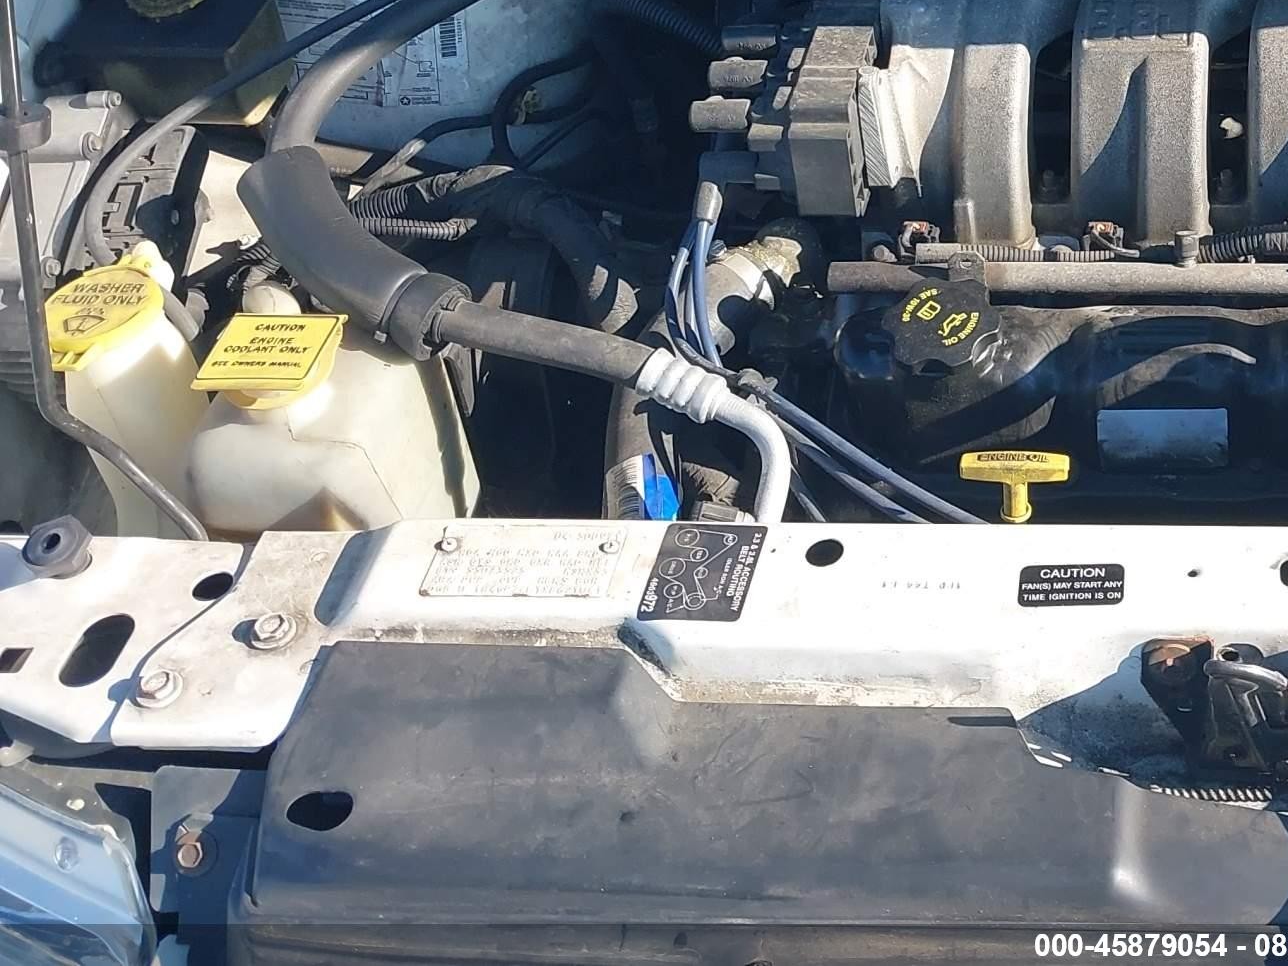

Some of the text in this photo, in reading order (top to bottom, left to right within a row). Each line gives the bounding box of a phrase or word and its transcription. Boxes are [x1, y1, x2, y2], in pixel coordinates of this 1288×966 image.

[72, 283, 145, 295] WASHER
[919, 288, 938, 300] SAE
[51, 294, 148, 305] FLUID ONLY
[255, 323, 306, 332] CAUTION
[941, 312, 980, 346] ENGINE OIL
[250, 337, 295, 345] ENGINE
[223, 345, 311, 354] COOLANT ONLY
[976, 452, 1048, 463] ENGINE OIL
[724, 545, 749, 596] BELT ROUTING
[1040, 567, 1106, 580] CAUTION
[728, 566, 752, 611] ACCESSORY
[1021, 580, 1123, 591] FAN(S) MAY START ANY
[1023, 591, 1122, 601] TIME IGNITION IS ON
